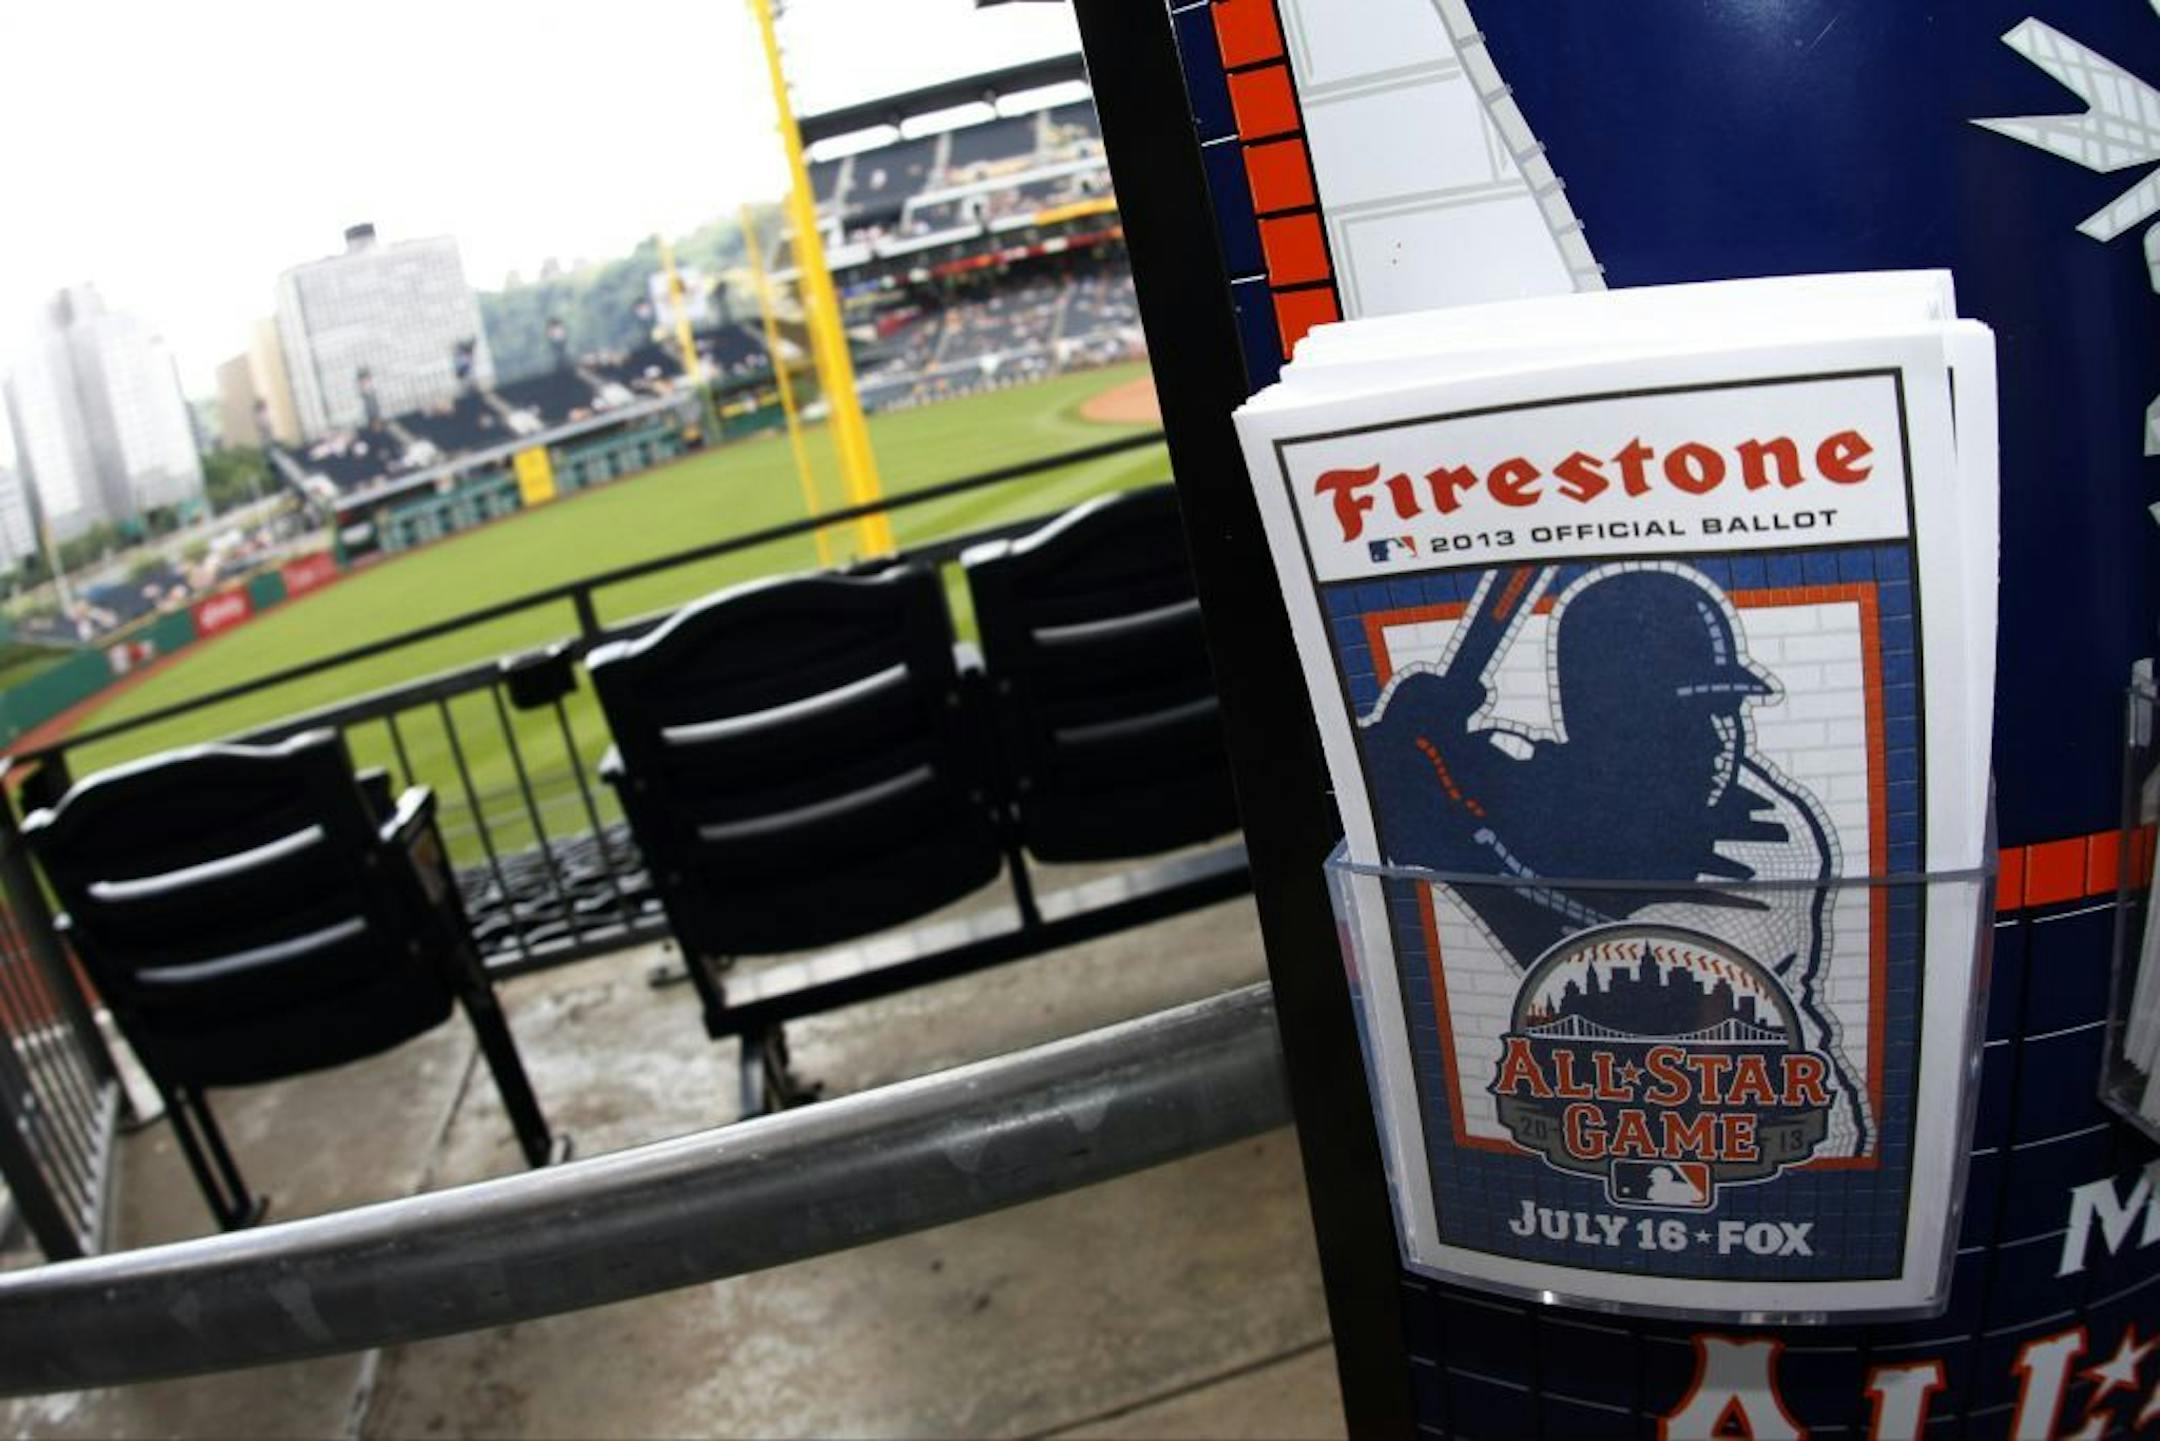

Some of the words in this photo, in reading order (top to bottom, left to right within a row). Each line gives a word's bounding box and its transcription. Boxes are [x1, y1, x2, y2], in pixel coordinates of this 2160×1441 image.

[1315, 430, 1874, 542] Firestone
[1430, 530, 1515, 553] 2013
[1531, 519, 1686, 543] OFFICIAL
[1701, 509, 1838, 535] BALLOT
[1563, 1102, 1760, 1162] GAME
[1508, 1200, 1630, 1247] JULY
[1636, 1218, 1688, 1251] 16
[1717, 1220, 1814, 1257] FOX
